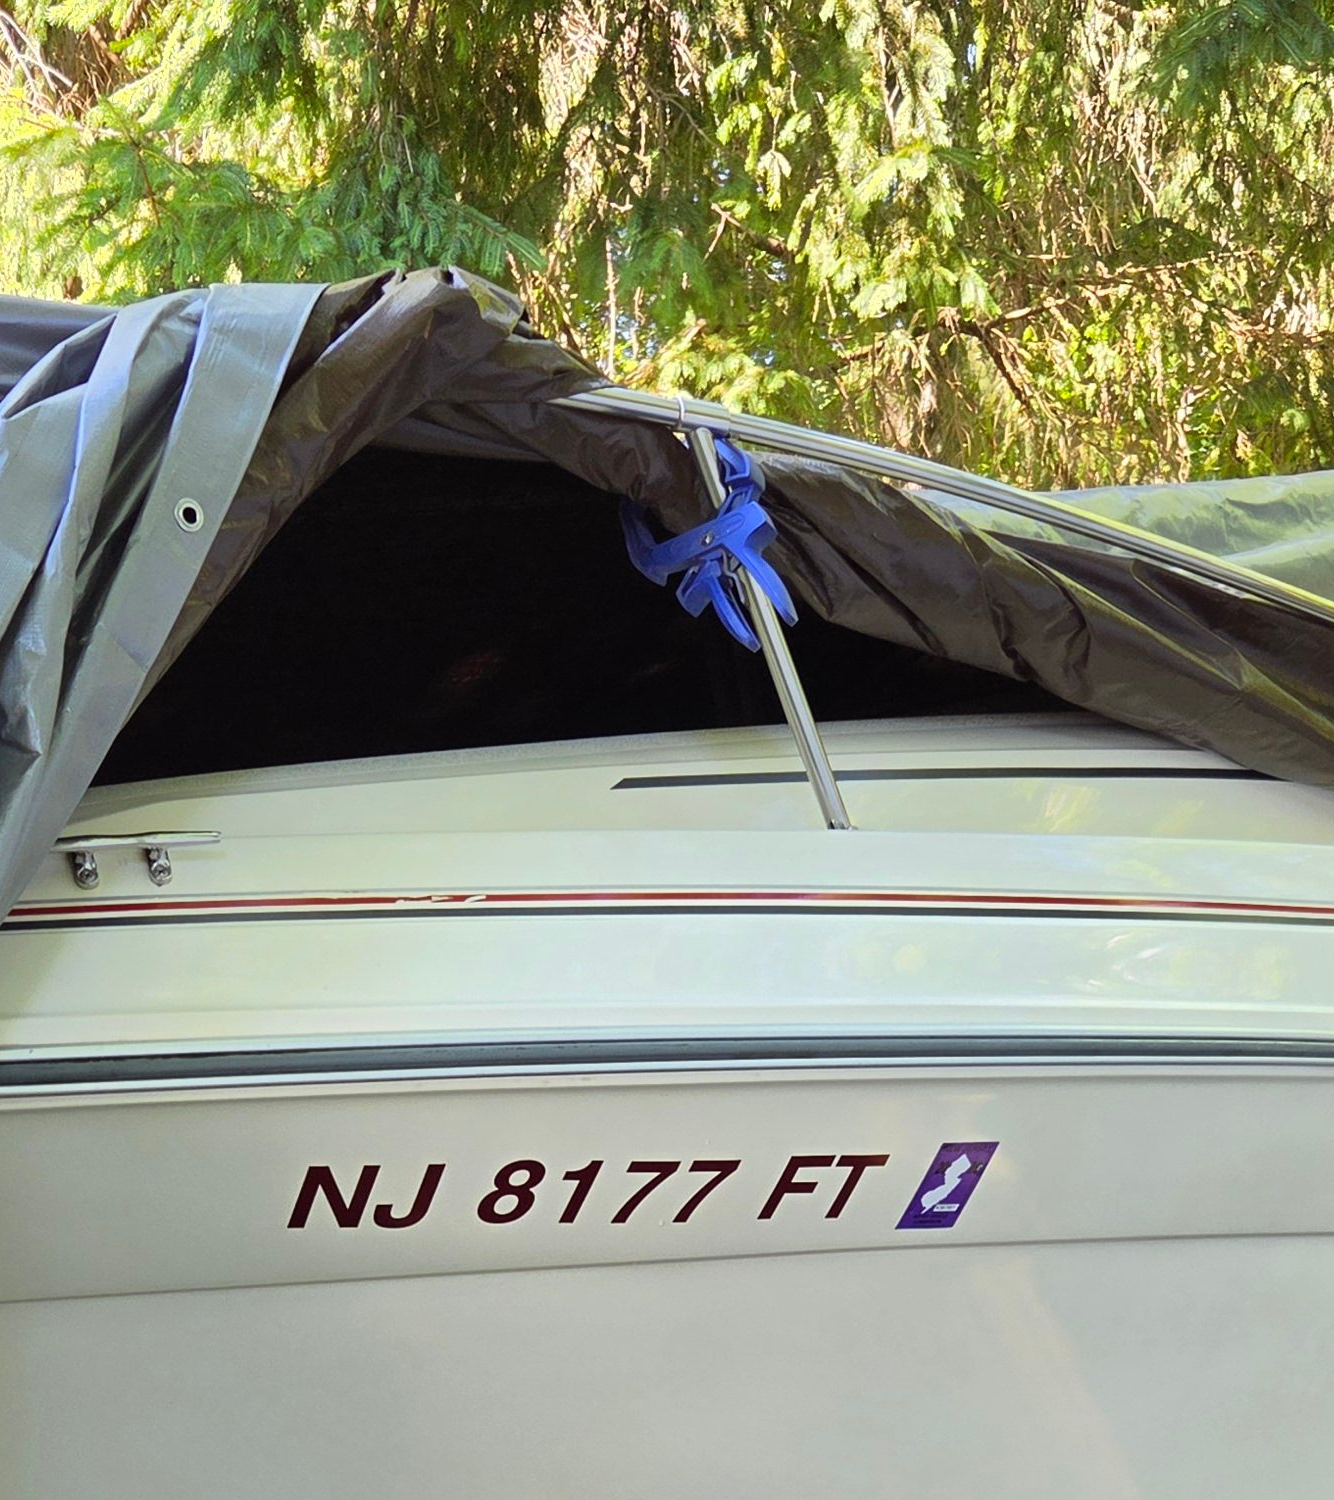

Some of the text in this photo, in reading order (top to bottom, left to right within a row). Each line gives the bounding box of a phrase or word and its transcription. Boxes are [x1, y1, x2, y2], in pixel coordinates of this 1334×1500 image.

[287, 1153, 891, 1230] NJ 8177 FT
